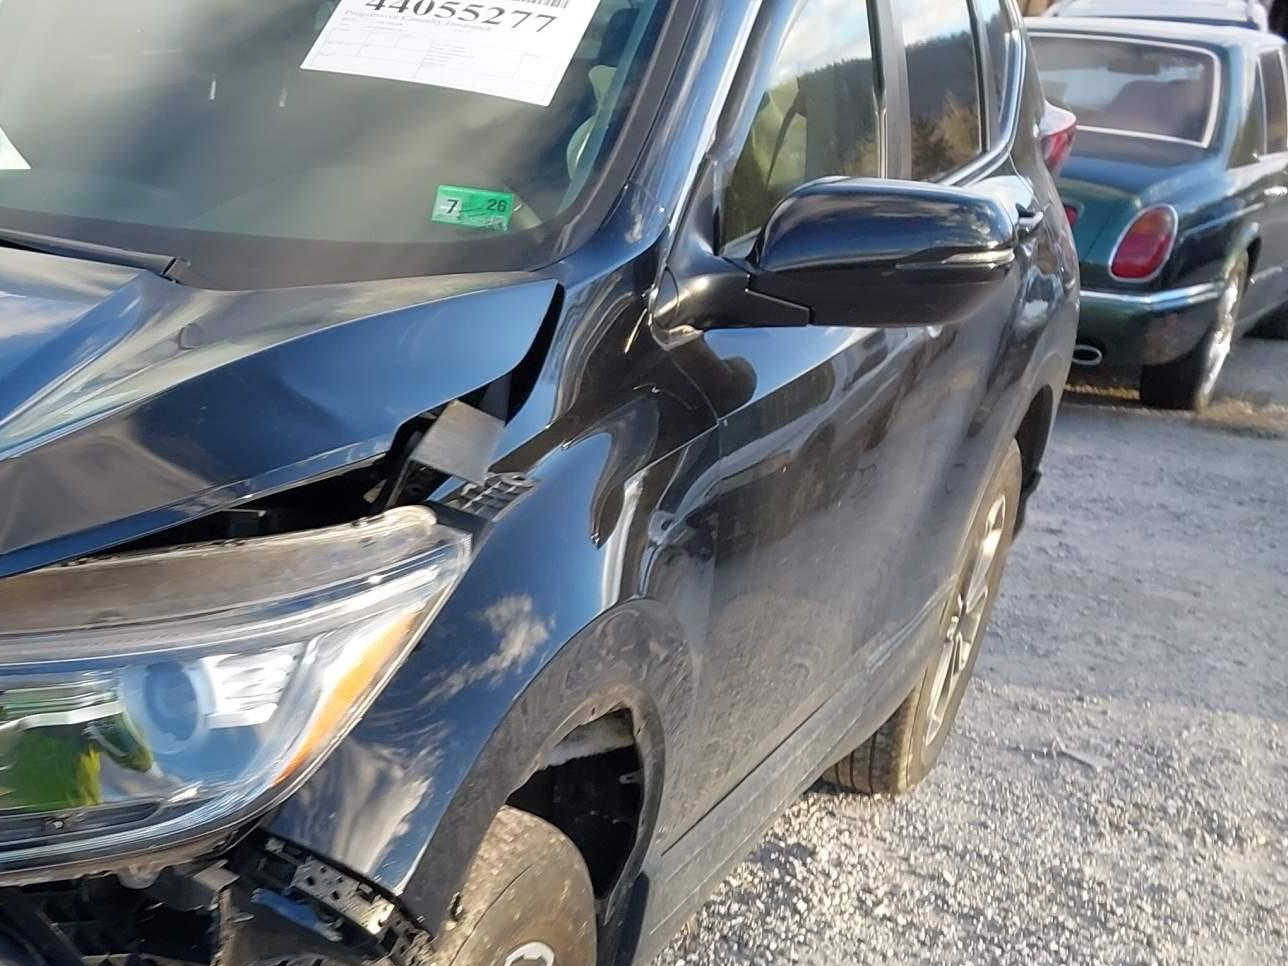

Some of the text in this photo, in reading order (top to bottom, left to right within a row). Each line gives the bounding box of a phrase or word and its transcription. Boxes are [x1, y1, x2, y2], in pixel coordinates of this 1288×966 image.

[364, 0, 558, 32] 44055277
[447, 199, 508, 214] 7 26
